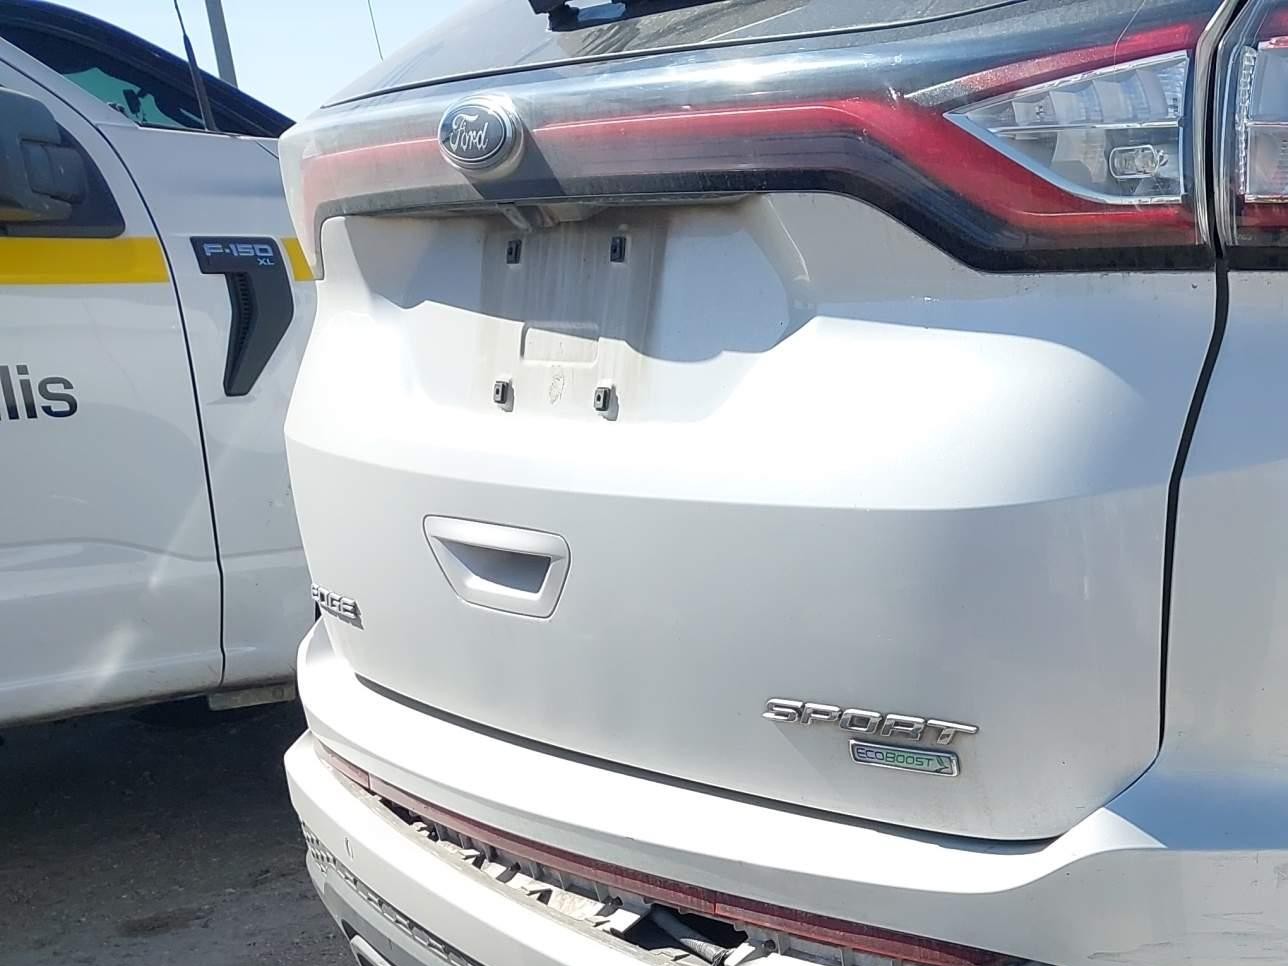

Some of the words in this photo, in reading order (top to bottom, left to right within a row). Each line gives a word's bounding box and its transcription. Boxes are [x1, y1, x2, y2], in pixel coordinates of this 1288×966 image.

[449, 113, 488, 152] Ford
[203, 243, 274, 256] F-150
[0, 365, 78, 420] lis
[762, 698, 979, 745] SPORT
